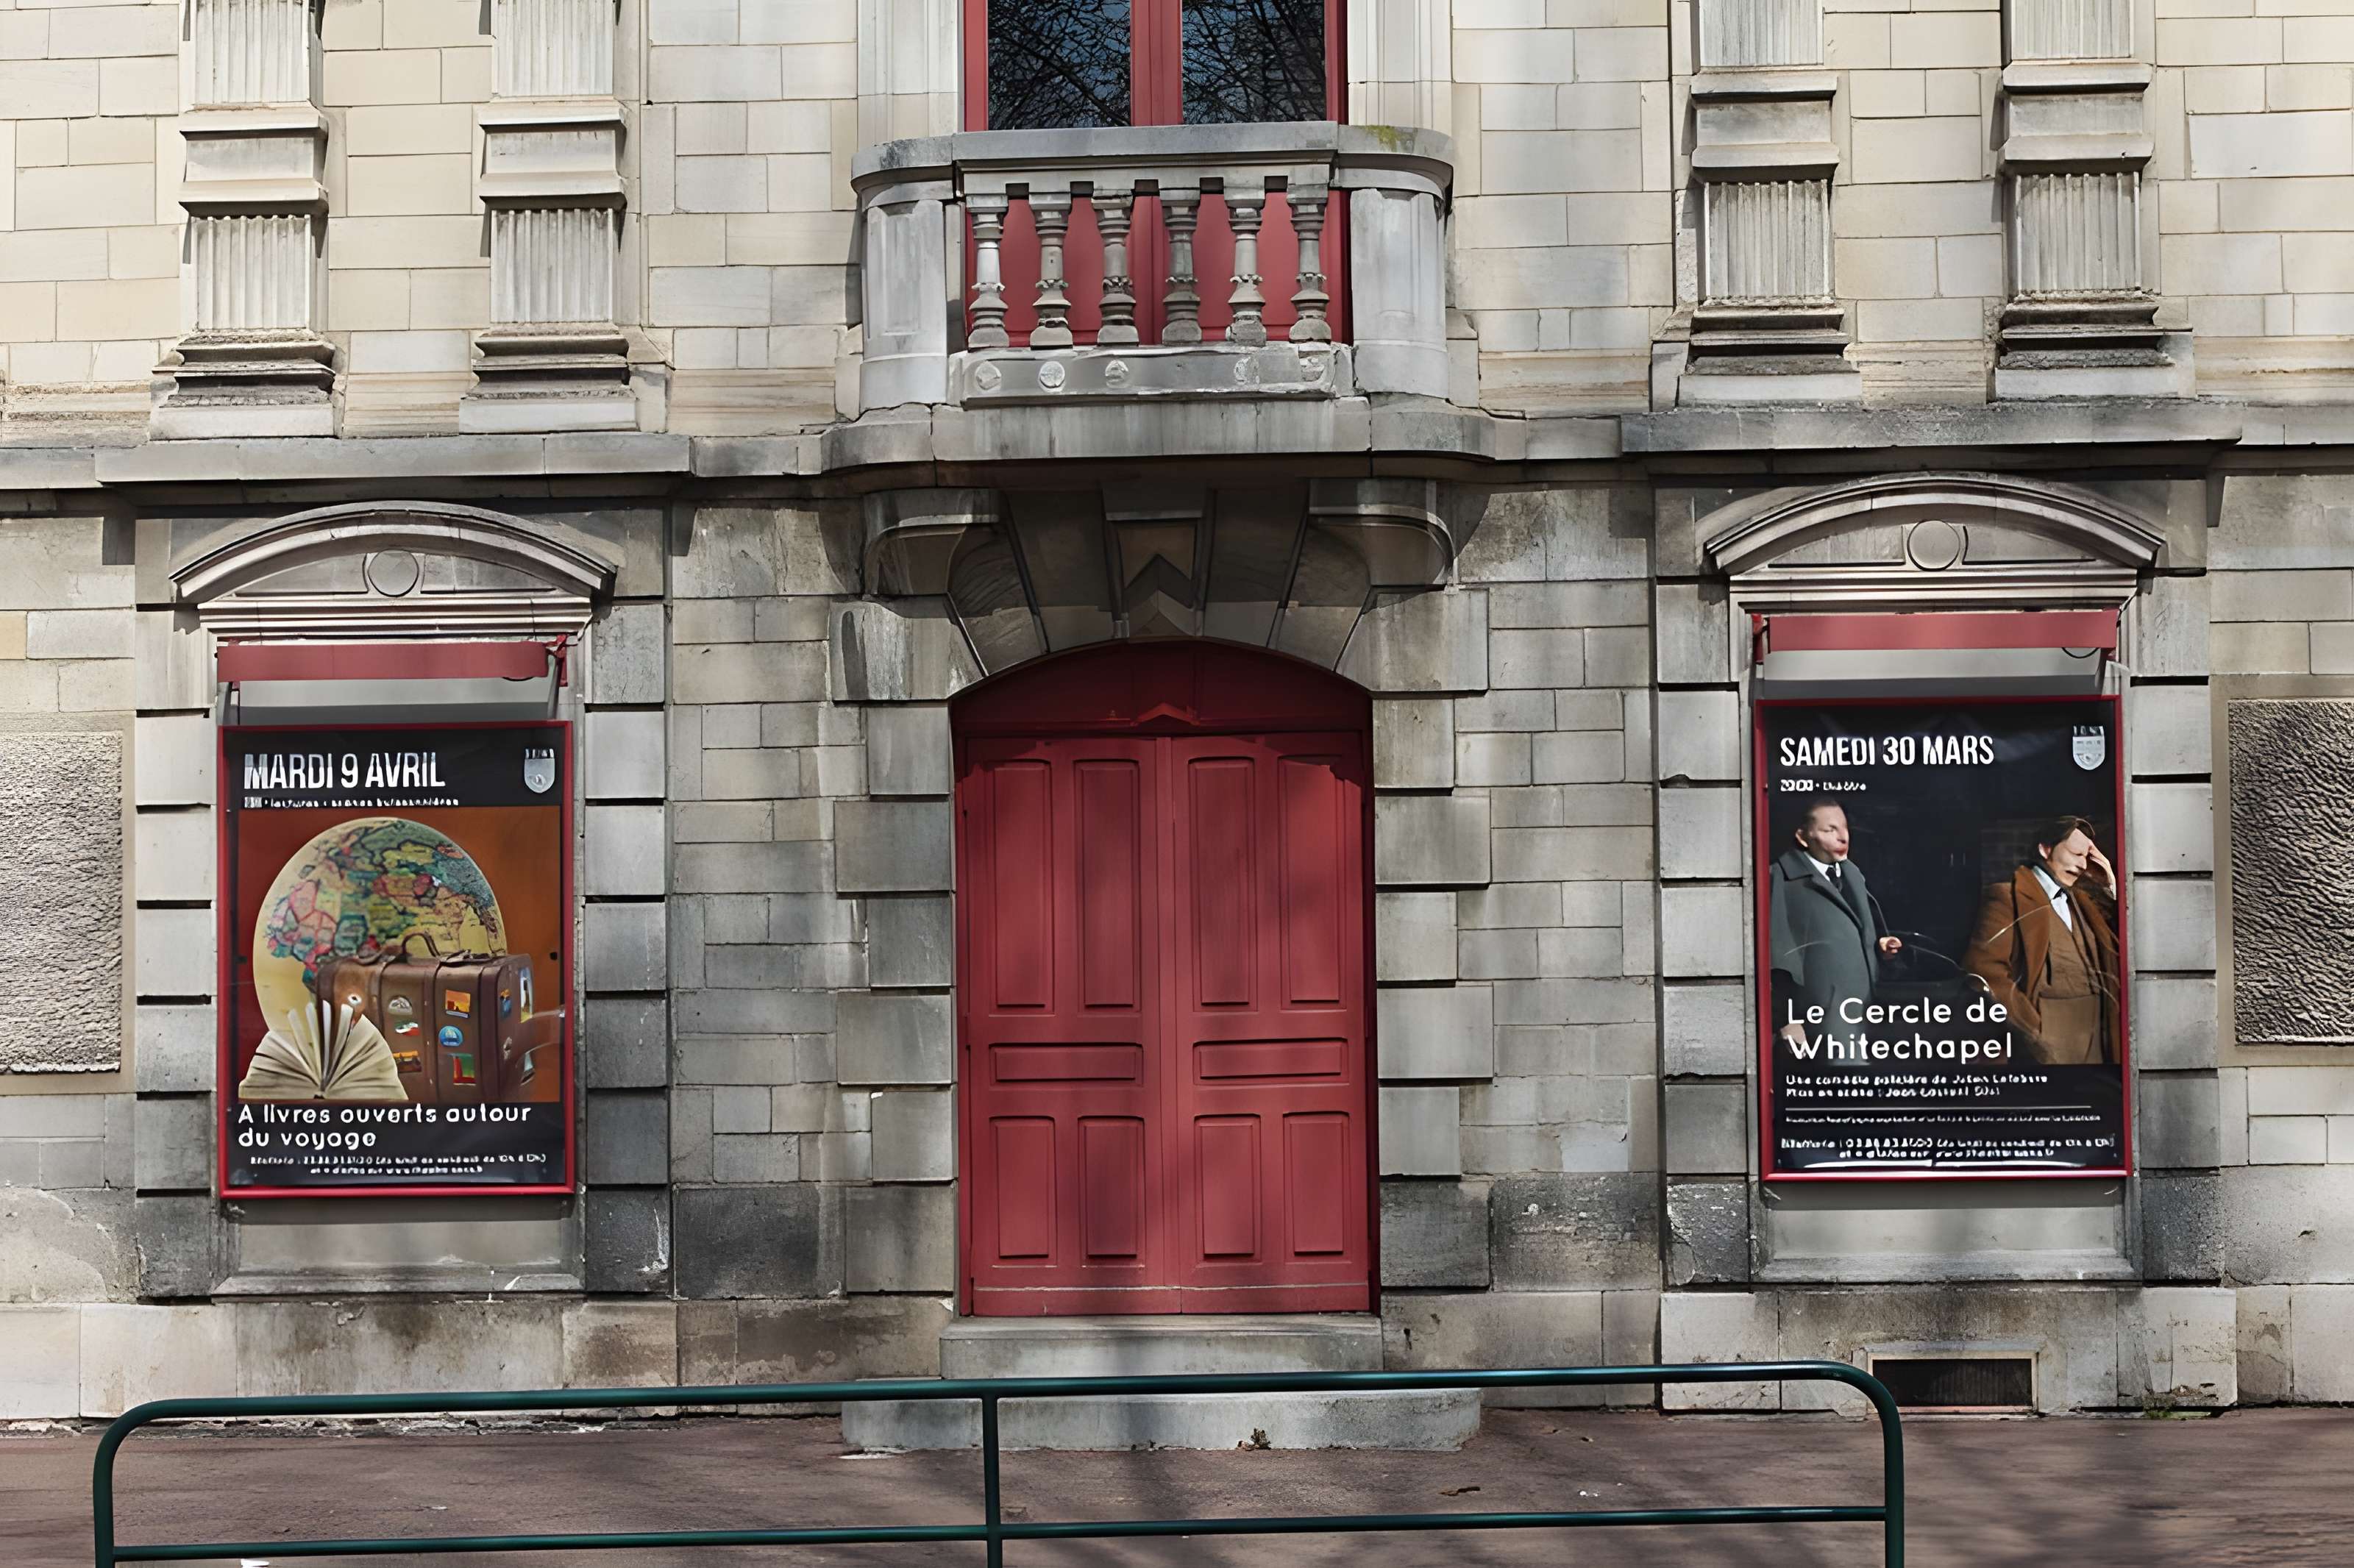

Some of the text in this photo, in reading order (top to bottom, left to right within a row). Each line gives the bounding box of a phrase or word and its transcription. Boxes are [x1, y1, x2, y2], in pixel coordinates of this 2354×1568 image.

[1780, 735, 1994, 766] SAMEDI 30 MARS
[243, 752, 446, 790] MARDI 9 AVRIL
[1788, 997, 2008, 1024] Le Cercle de
[1787, 1032, 2011, 1064] Whitechapel
[263, 1103, 330, 1124] livres
[340, 1102, 437, 1124] ouverts
[446, 1102, 531, 1122] autour
[238, 1127, 377, 1151] du voyage
